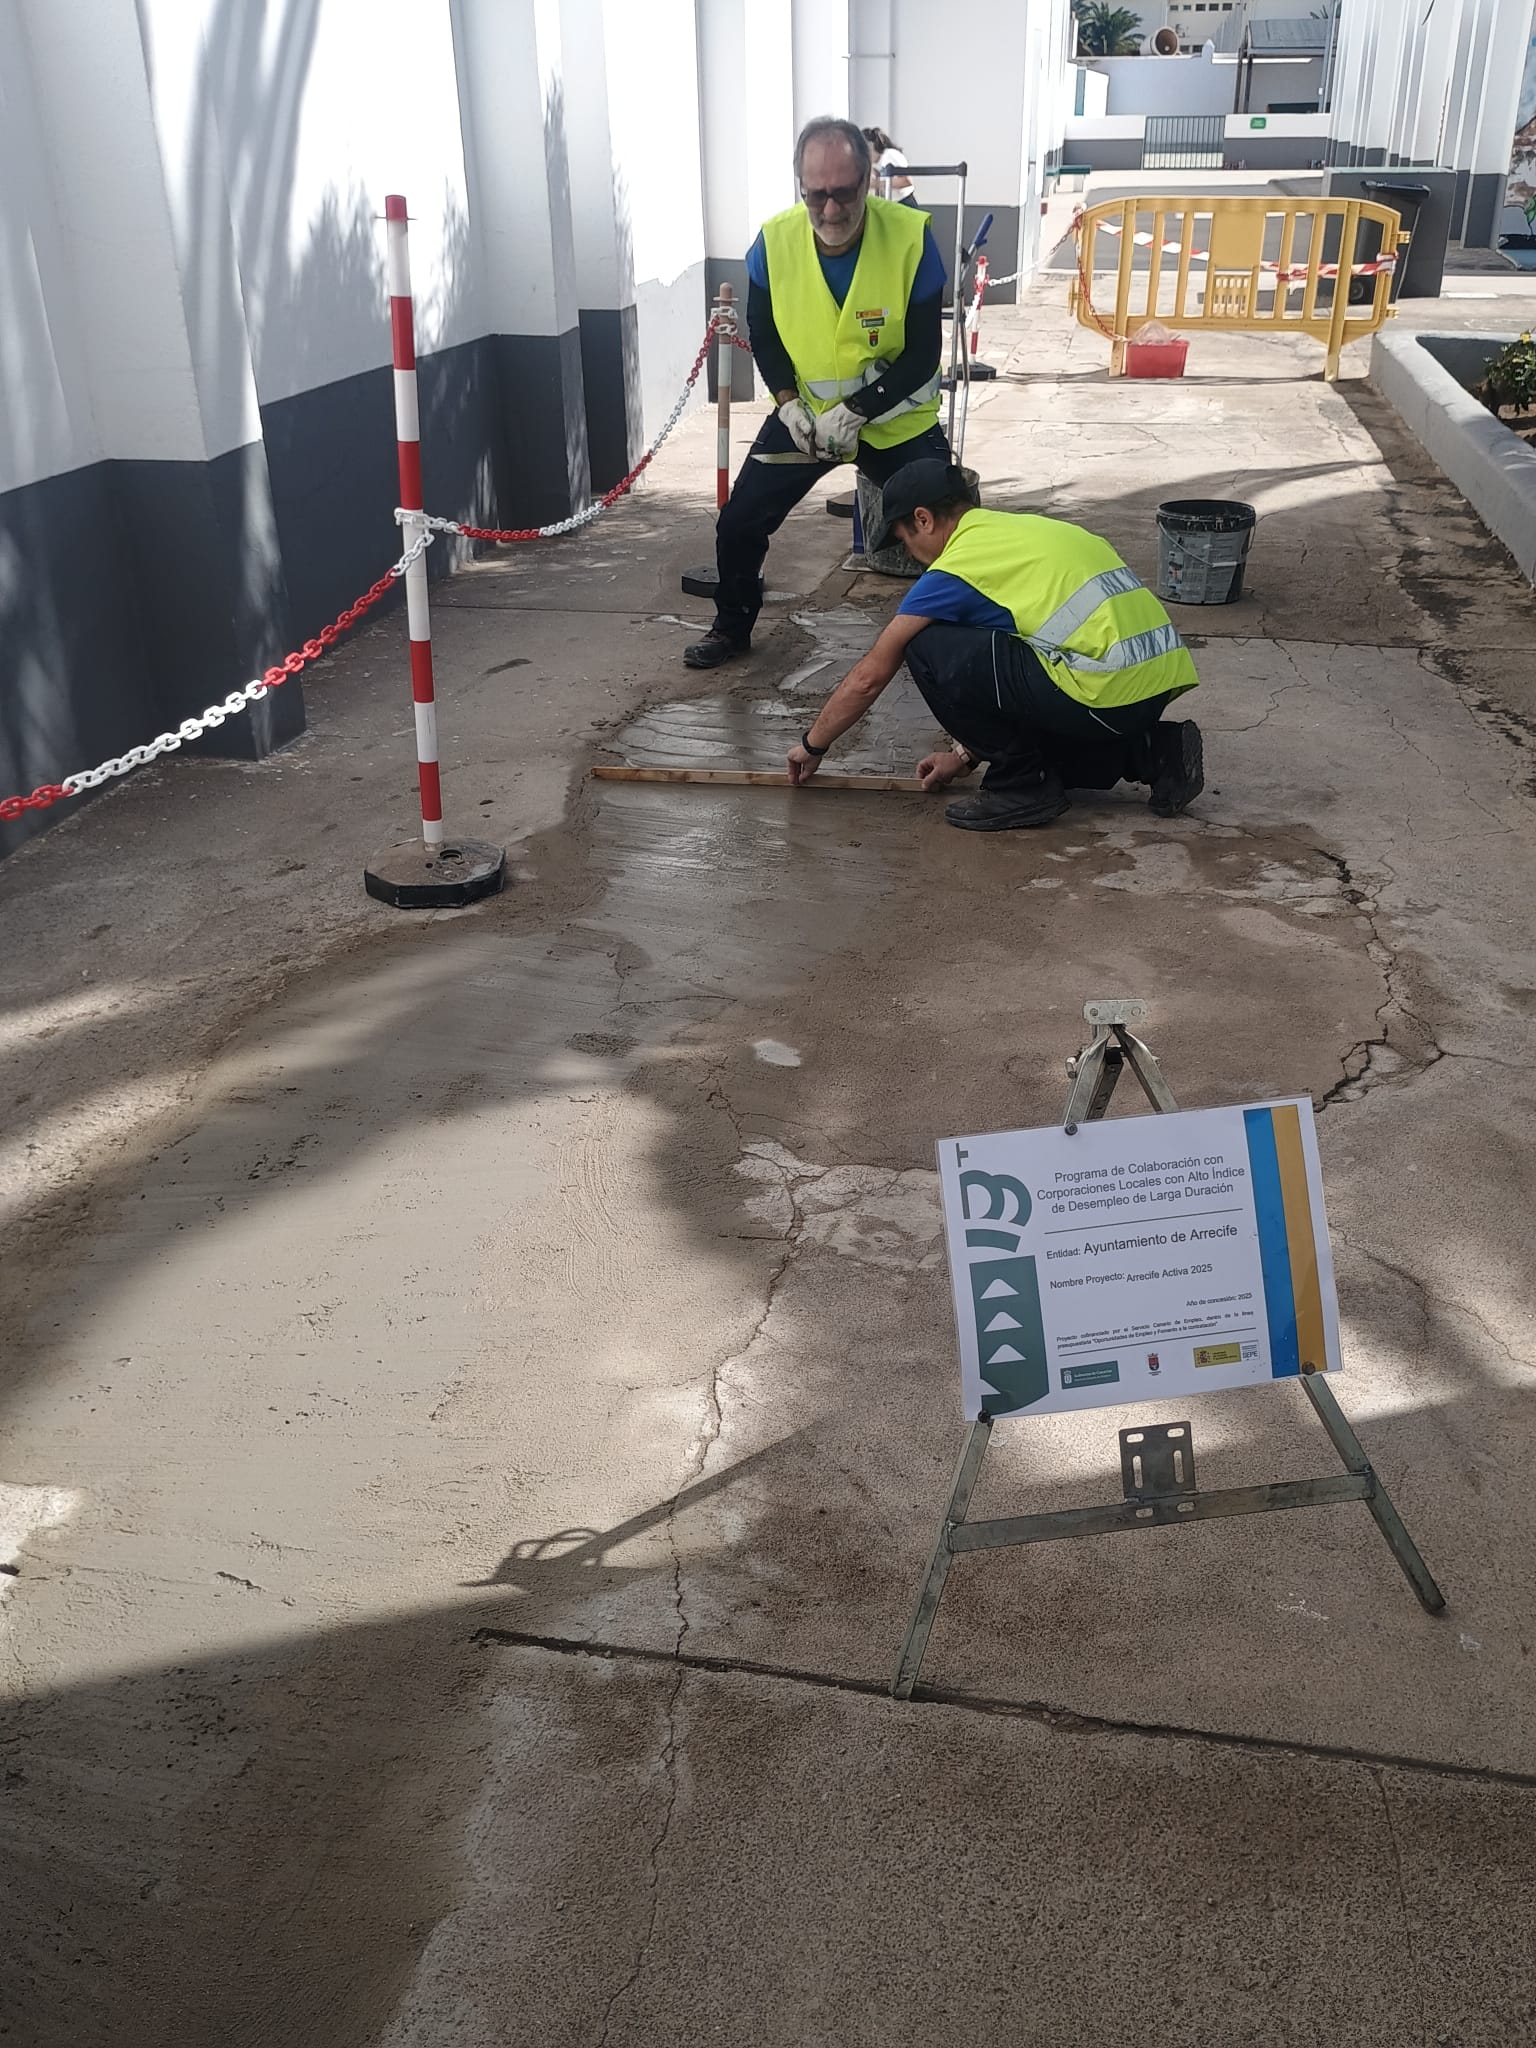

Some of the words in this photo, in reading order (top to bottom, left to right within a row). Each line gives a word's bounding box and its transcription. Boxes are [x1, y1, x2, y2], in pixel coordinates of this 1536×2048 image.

[1037, 1184, 1116, 1200] Corporaciones
[1119, 1176, 1162, 1190] Locales
[1164, 1174, 1184, 1185] con
[1188, 1170, 1209, 1182] Alto
[1212, 1166, 1245, 1180] Índice
[1054, 1168, 1108, 1183] Programa
[1111, 1166, 1124, 1176] de
[1128, 1157, 1200, 1174] Colaboración
[1204, 1155, 1224, 1166] con
[1052, 1203, 1065, 1214] de
[1068, 1196, 1130, 1212] Desempleo
[1132, 1192, 1146, 1203] de
[1150, 1188, 1182, 1202] Larga
[1184, 1182, 1234, 1198] Duración
[1046, 1249, 1081, 1260] Entidad:
[1084, 1234, 1167, 1256] Ayuntamiento
[1170, 1231, 1186, 1243] de
[1190, 1224, 1238, 1241] Arrecife
[1050, 1278, 1084, 1289] Nombre
[1086, 1272, 1125, 1284] Proyecto:
[1126, 1271, 1160, 1282] Arrecife
[1162, 1268, 1188, 1278] Activa
[1190, 1264, 1212, 1274] 2025
